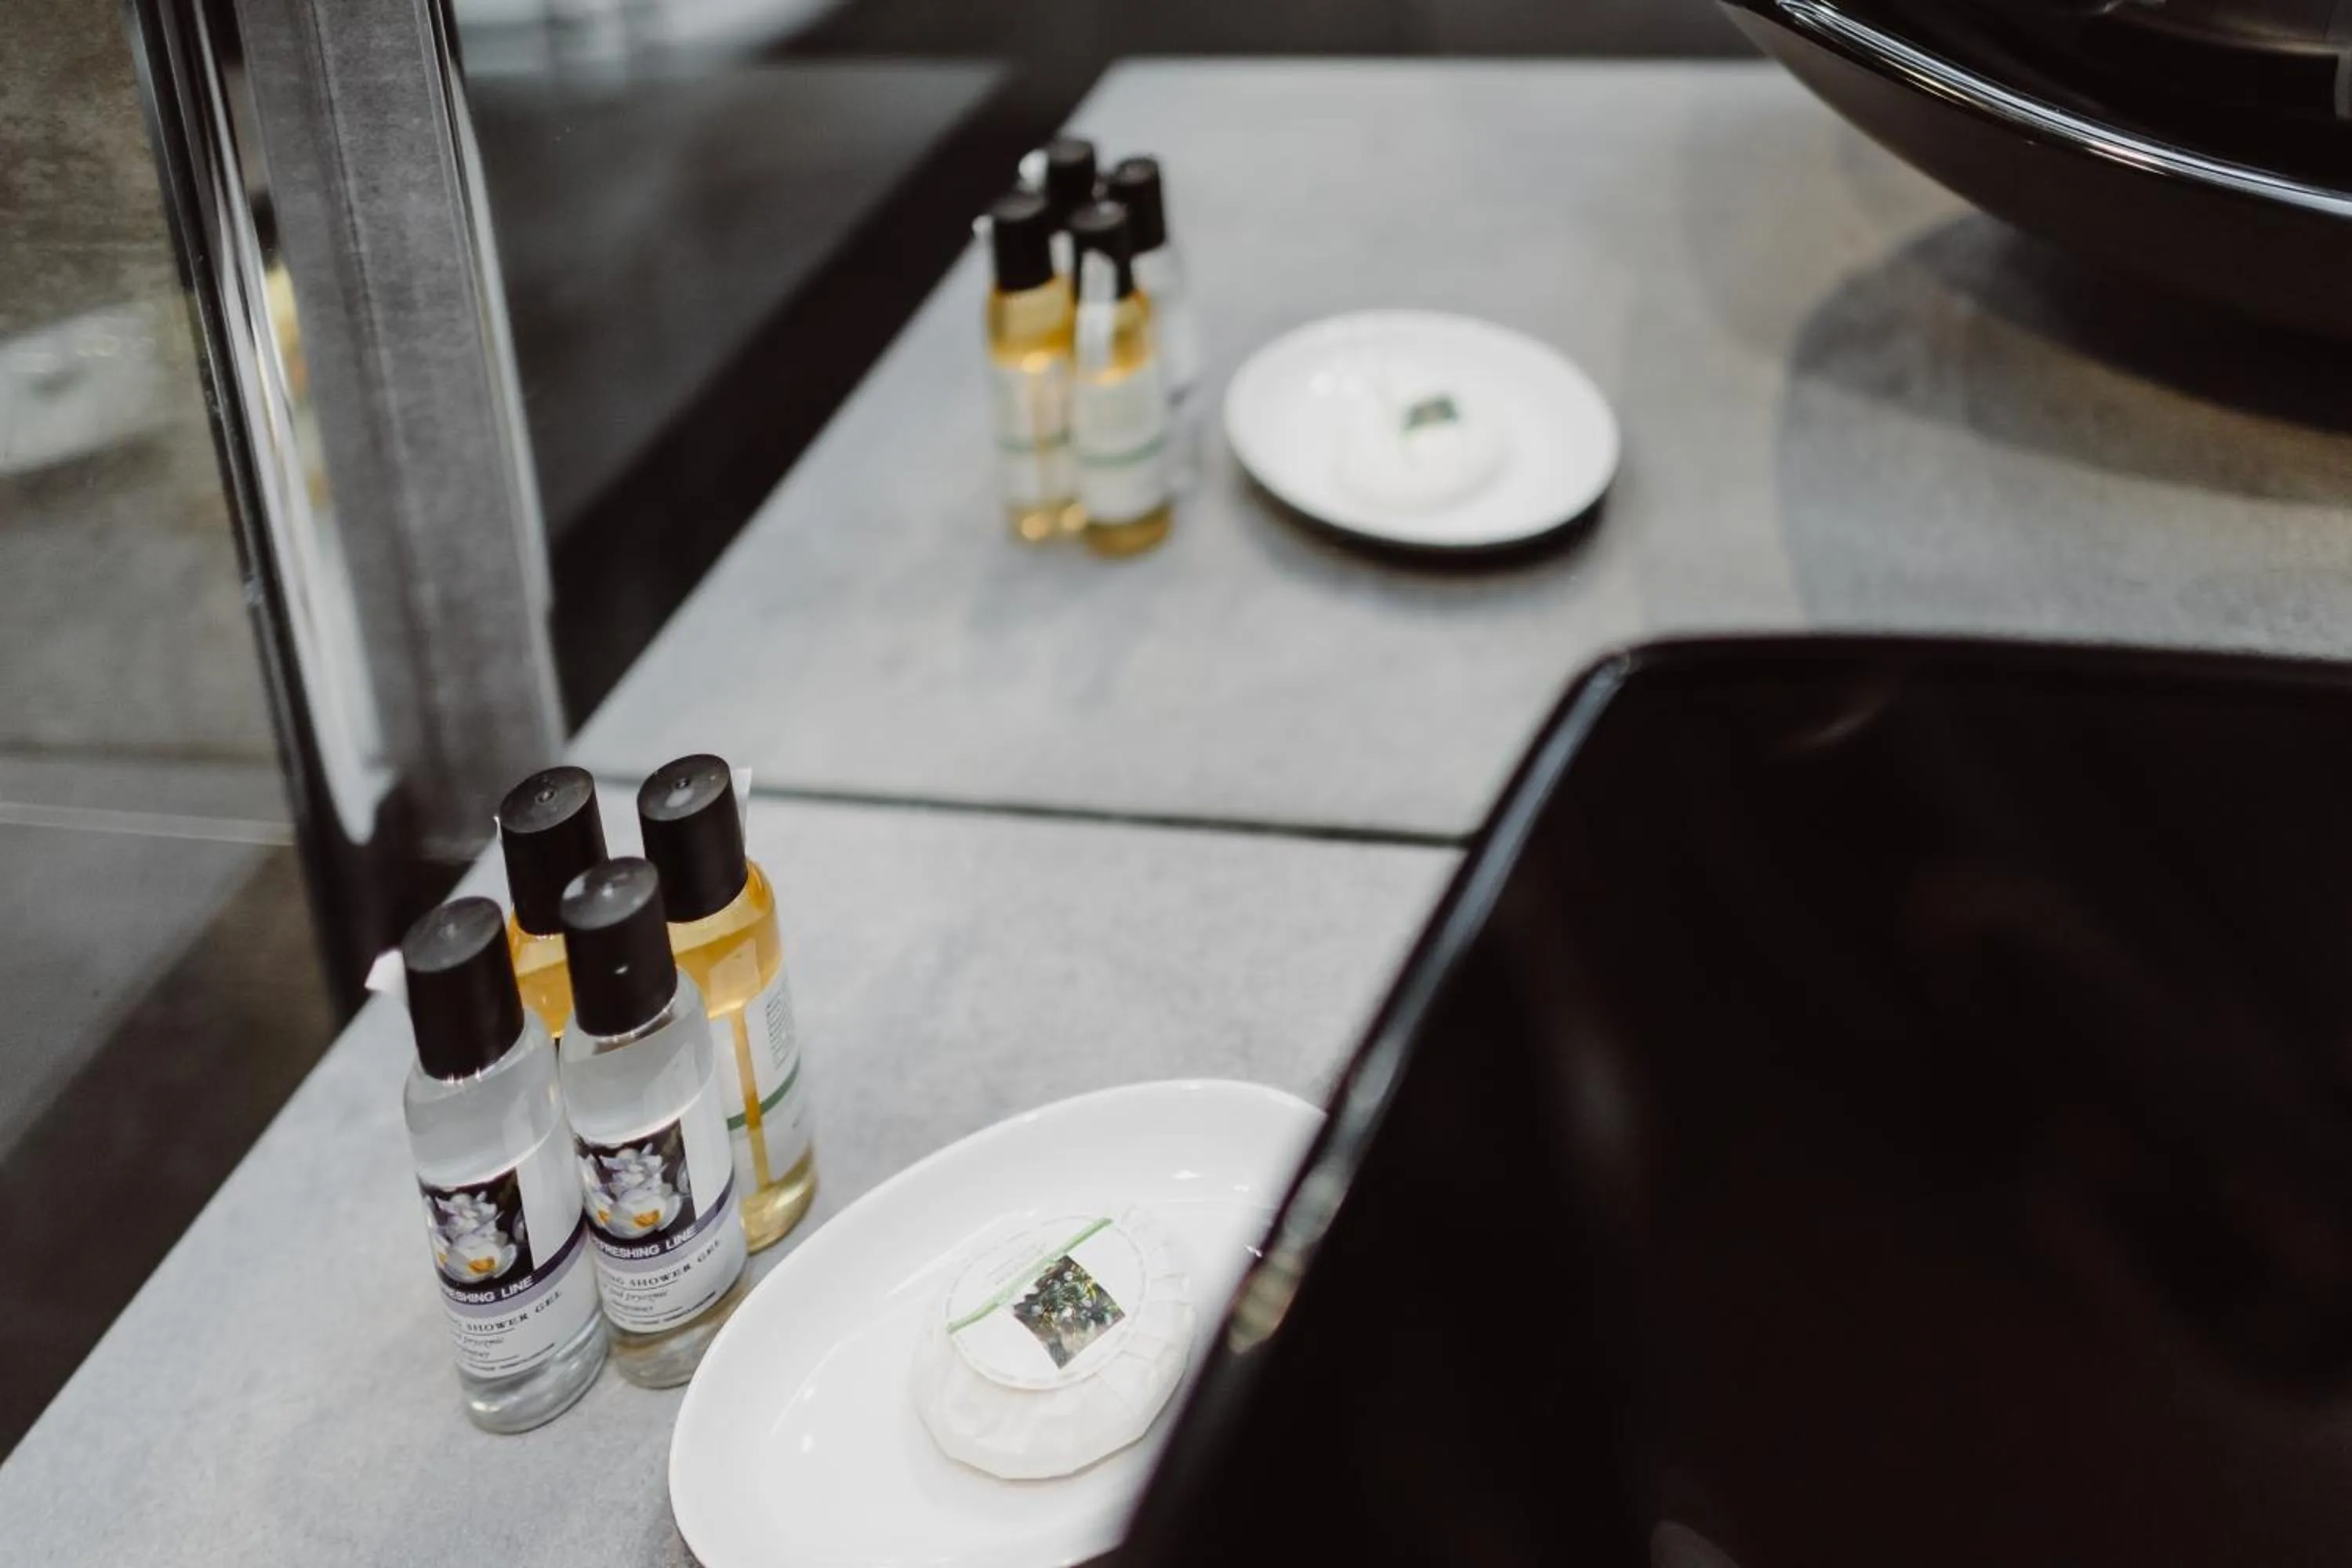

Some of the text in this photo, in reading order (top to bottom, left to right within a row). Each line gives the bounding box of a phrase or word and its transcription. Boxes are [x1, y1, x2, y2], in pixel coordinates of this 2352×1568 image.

[666, 1225, 695, 1250] LINE
[501, 1275, 533, 1298] LINE
[629, 1263, 691, 1287] SHOWER
[466, 1312, 528, 1332] SHOWER
